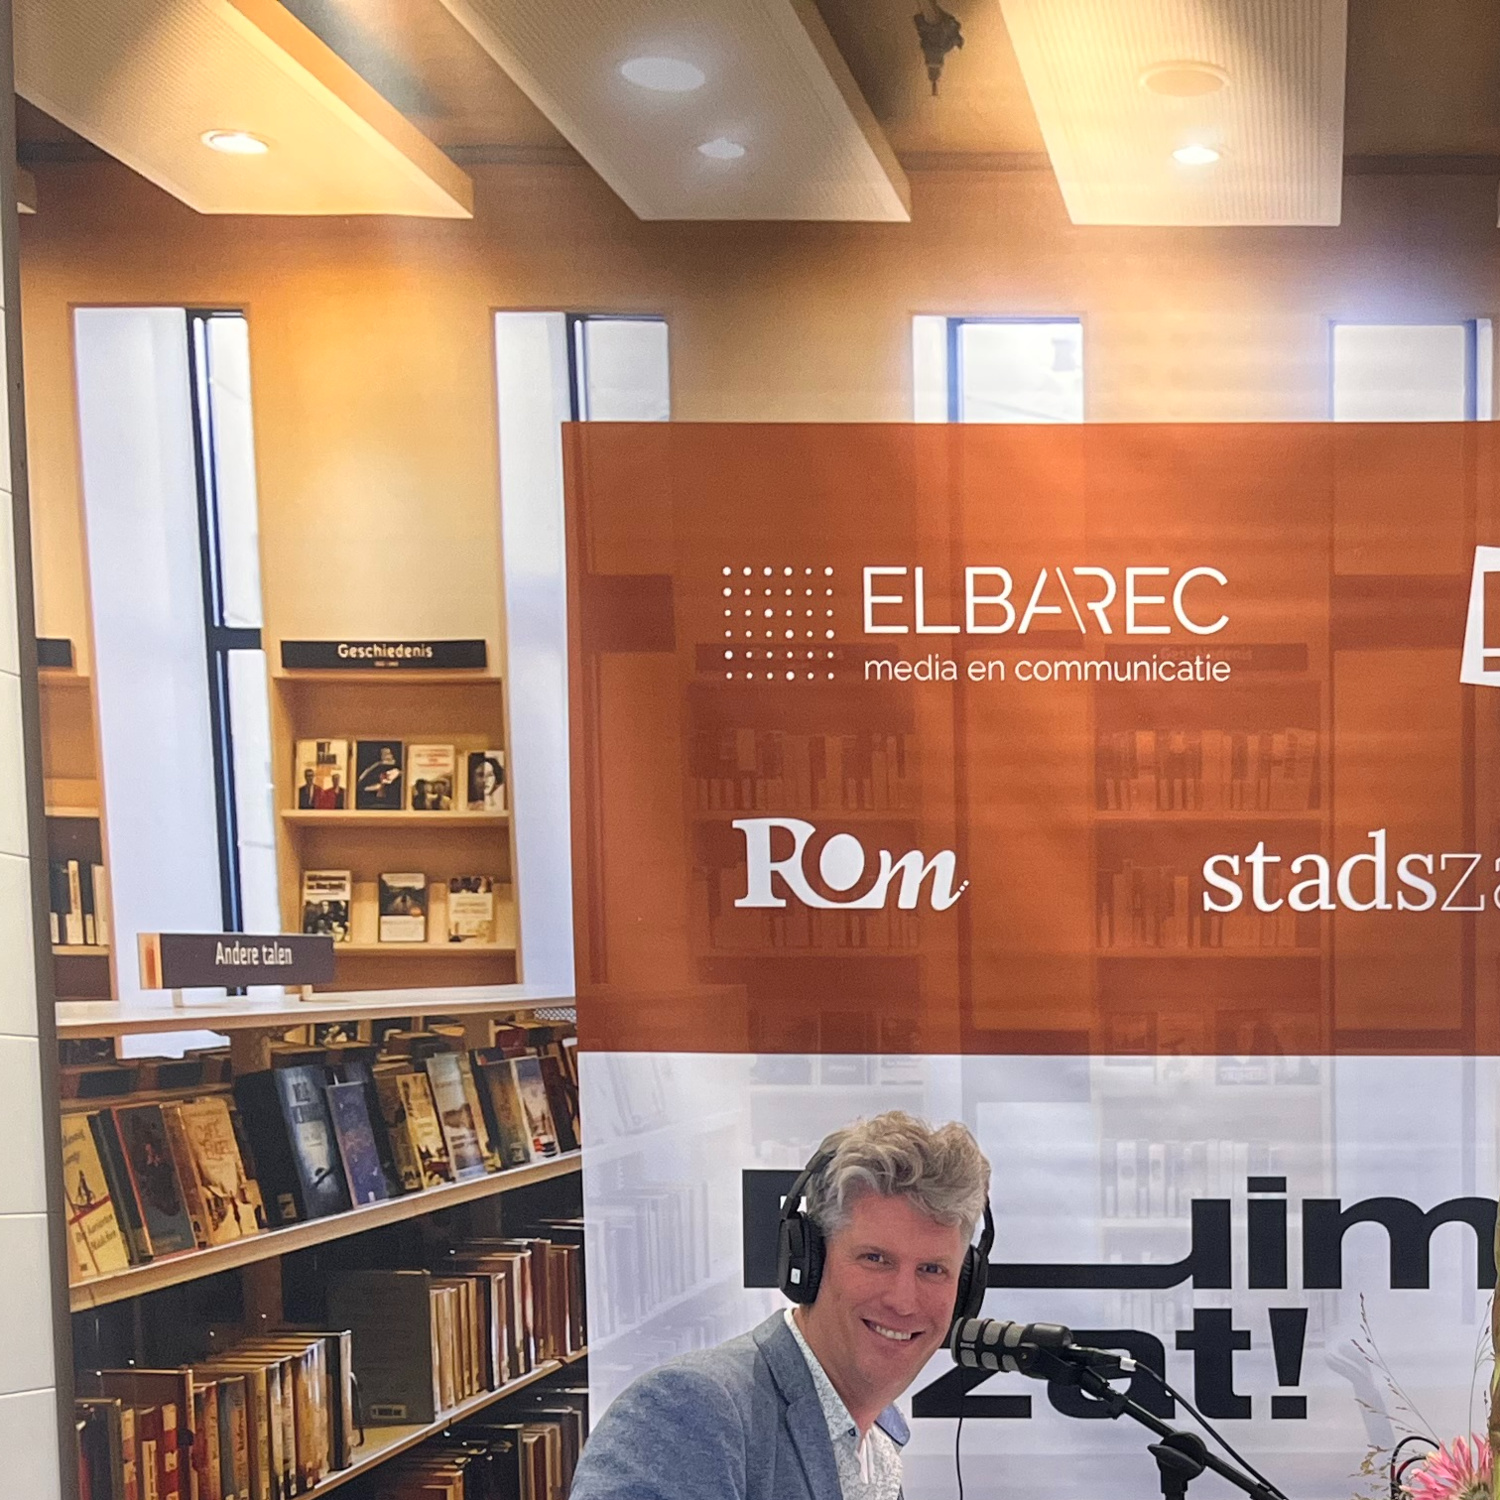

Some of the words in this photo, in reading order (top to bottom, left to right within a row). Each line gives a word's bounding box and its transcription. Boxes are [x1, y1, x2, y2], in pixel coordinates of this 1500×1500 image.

[864, 566, 1230, 635] ELBAREC
[337, 643, 433, 658] Geschiedenis
[864, 654, 958, 682] media
[967, 660, 1005, 682] en
[1014, 654, 1231, 682] communicatie
[215, 940, 259, 965] Andere
[262, 941, 293, 965] talen
